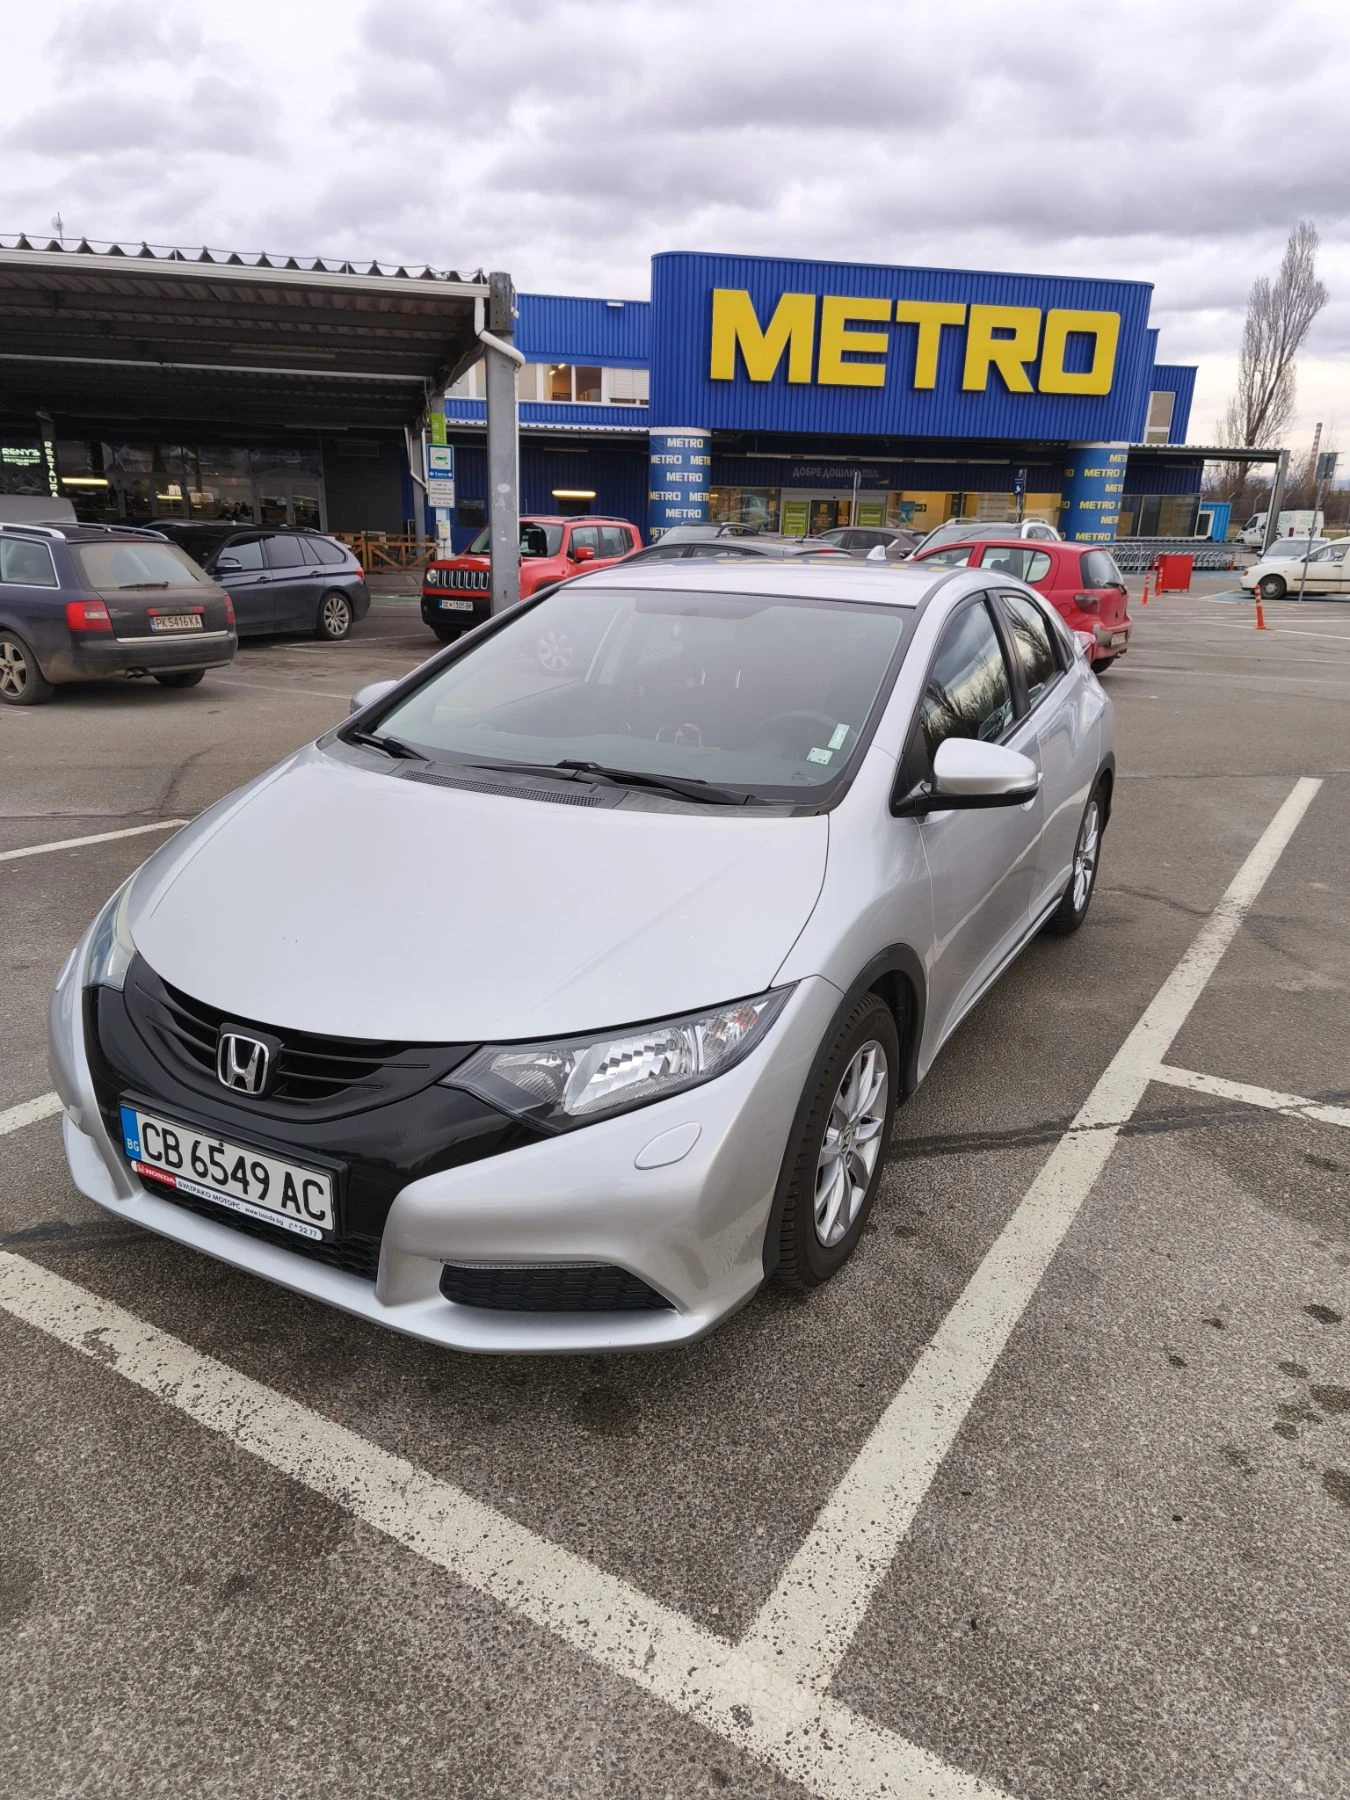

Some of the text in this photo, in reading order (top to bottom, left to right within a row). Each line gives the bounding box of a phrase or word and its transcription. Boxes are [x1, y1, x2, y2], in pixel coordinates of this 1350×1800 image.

[709, 287, 1120, 396] METRO
[667, 438, 704, 448] METRO
[2, 448, 40, 456] RENY'S
[650, 455, 682, 464] METRO
[666, 472, 703, 482] METRO
[793, 467, 822, 478] ДОБРЕ
[1084, 469, 1120, 477] METRO
[649, 491, 681, 501] METRO
[1079, 501, 1115, 509] METRO
[665, 508, 702, 518] METRO
[1075, 532, 1110, 541] METRO
[156, 615, 201, 628] PK 5416 KA
[127, 1138, 140, 1152] BG
[141, 1122, 327, 1222] CB 6549 AC
[145, 1168, 176, 1184] HONDA
[212, 1194, 241, 1211] МОТОРС
